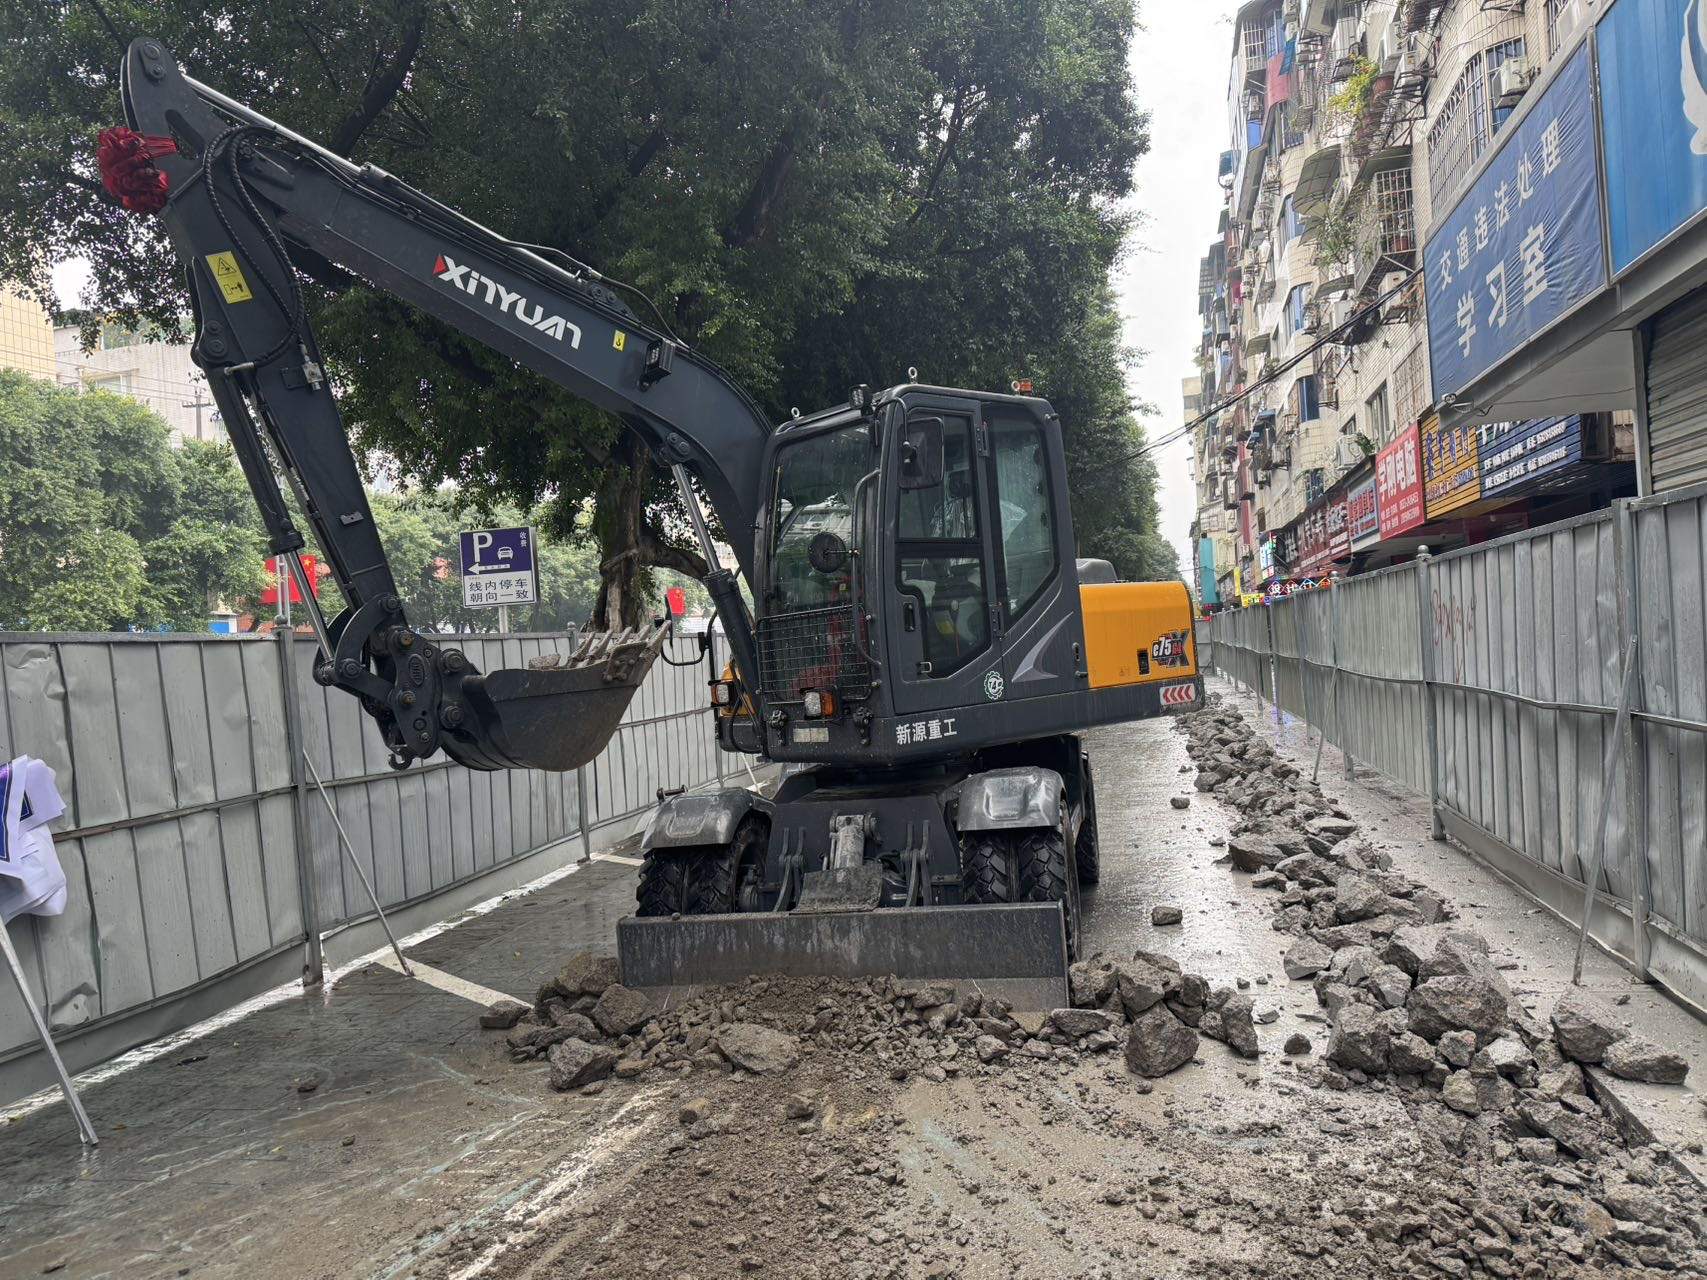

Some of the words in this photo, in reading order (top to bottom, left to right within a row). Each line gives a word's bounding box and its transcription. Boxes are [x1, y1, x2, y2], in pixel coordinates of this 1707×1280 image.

[1439, 117, 1561, 292] 交通违法处理
[1456, 222, 1550, 360] 学习室
[473, 532, 493, 563] P
[469, 578, 528, 592] 线内停车
[470, 589, 529, 603] 朝向一致
[895, 718, 958, 745] 新源重工
